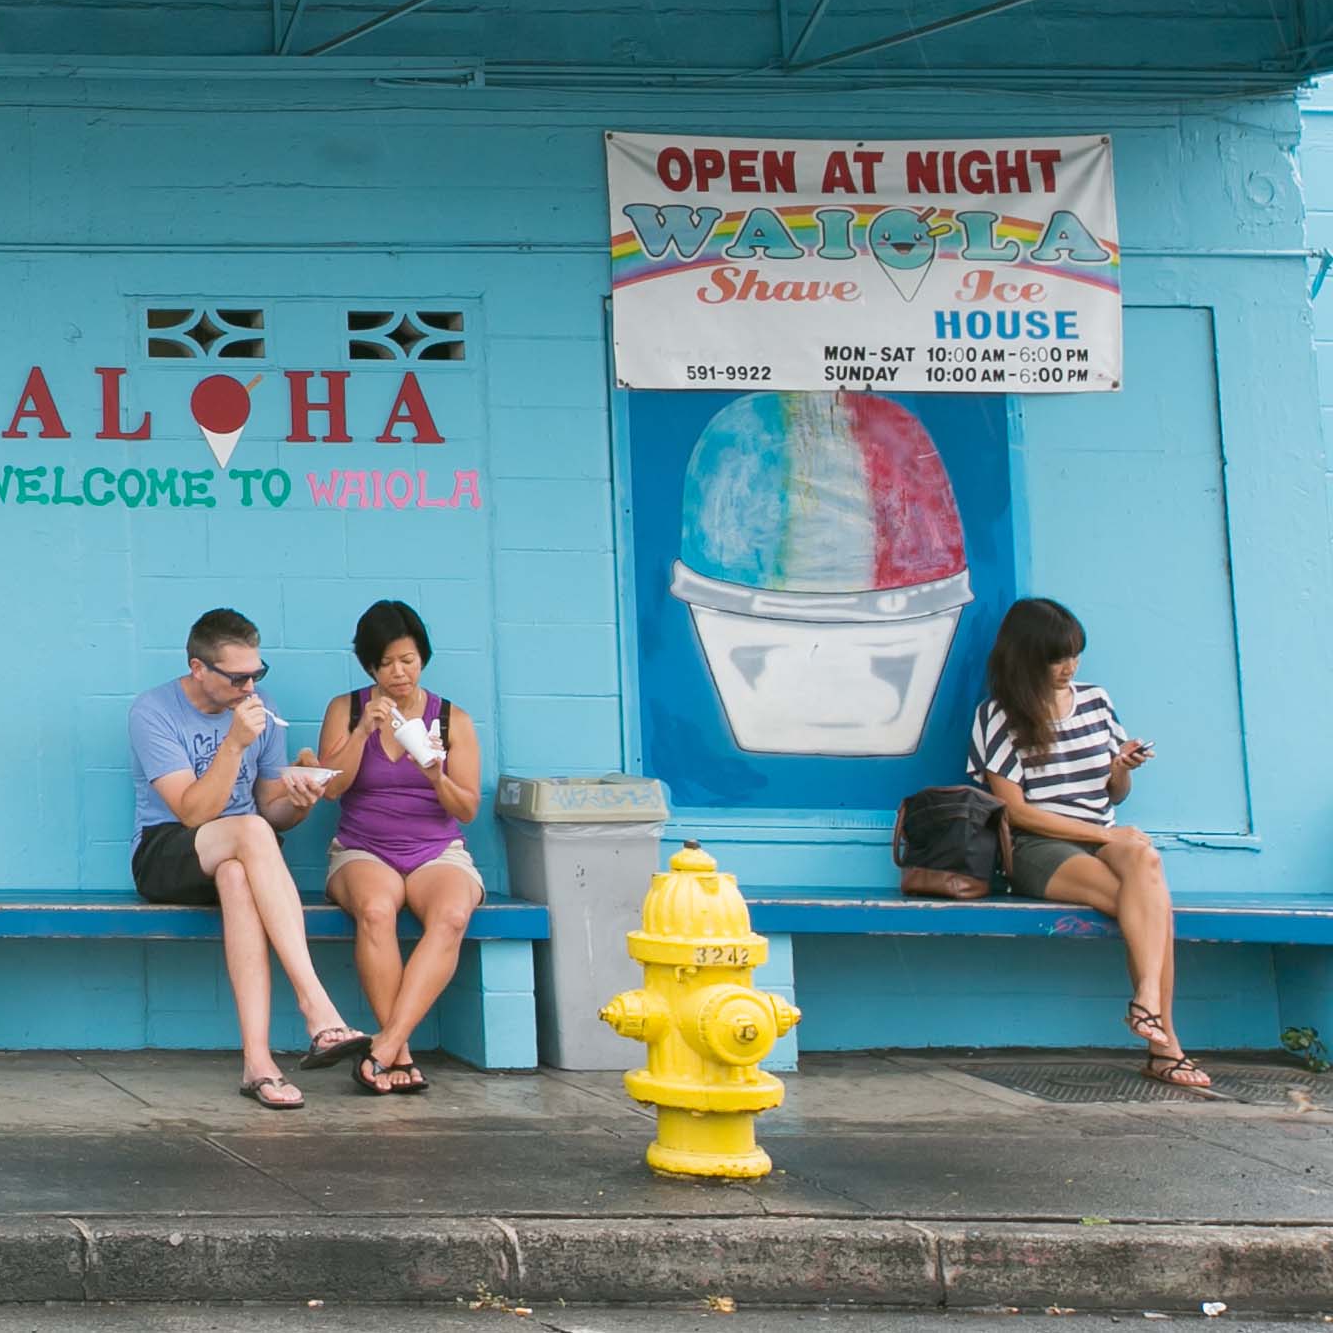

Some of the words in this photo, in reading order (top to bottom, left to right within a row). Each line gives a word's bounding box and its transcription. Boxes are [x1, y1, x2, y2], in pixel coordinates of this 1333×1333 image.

[656, 146, 797, 193] OPEN
[821, 150, 884, 194] AT
[905, 149, 1061, 194] NIGHT
[623, 202, 1113, 266] WAIOLA
[696, 267, 862, 304] Shave
[954, 269, 1047, 303] Ice
[934, 309, 1080, 340] HOUSE
[926, 346, 977, 363] 10:00
[1066, 349, 1089, 363] PM
[686, 365, 772, 381] 591-9922
[824, 366, 899, 382] SUNDAY
[925, 366, 977, 383] 10:00
[1067, 370, 1088, 383] PM
[2, 366, 445, 444] ALOHA
[229, 468, 292, 508] TO
[305, 470, 482, 508] WAIOLA
[695, 946, 749, 965] 3242
